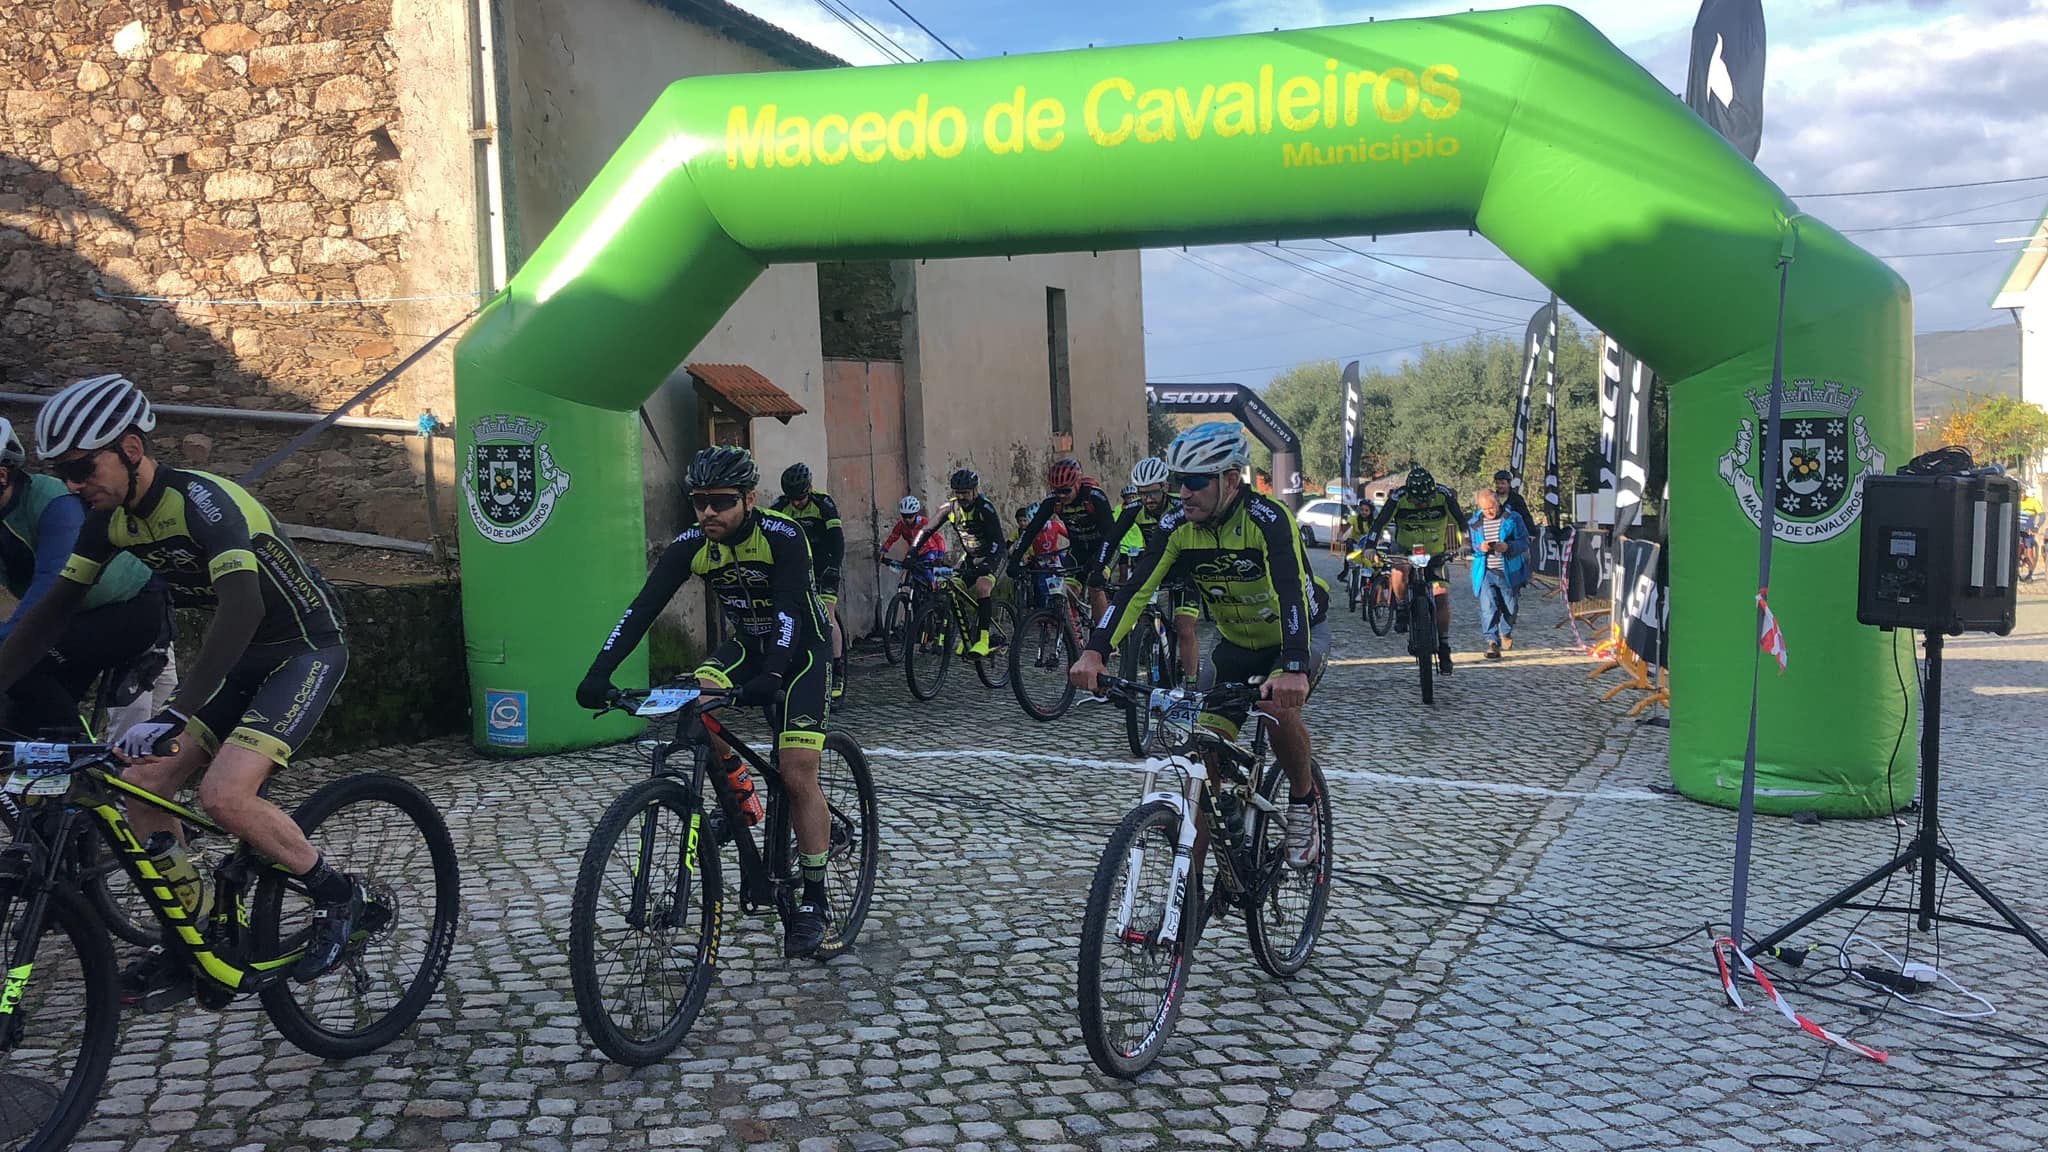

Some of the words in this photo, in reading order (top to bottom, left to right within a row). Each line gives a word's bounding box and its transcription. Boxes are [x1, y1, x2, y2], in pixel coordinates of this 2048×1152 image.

[726, 93, 968, 170] Macedo
[983, 85, 1066, 155] de
[1084, 58, 1462, 148] Cavaleiros
[1160, 391, 1238, 404] SCOTT
[470, 504, 493, 534] MACEDO
[493, 529, 504, 538] DE
[505, 503, 549, 538] CAVALEIROS
[1743, 494, 1784, 532] MACO
[1785, 524, 1803, 536] DE
[1805, 491, 1863, 537] CAVALEIROS
[274, 703, 301, 733] Clube
[295, 660, 322, 704] Ciclismo
[709, 900, 721, 966] MAXXIS
